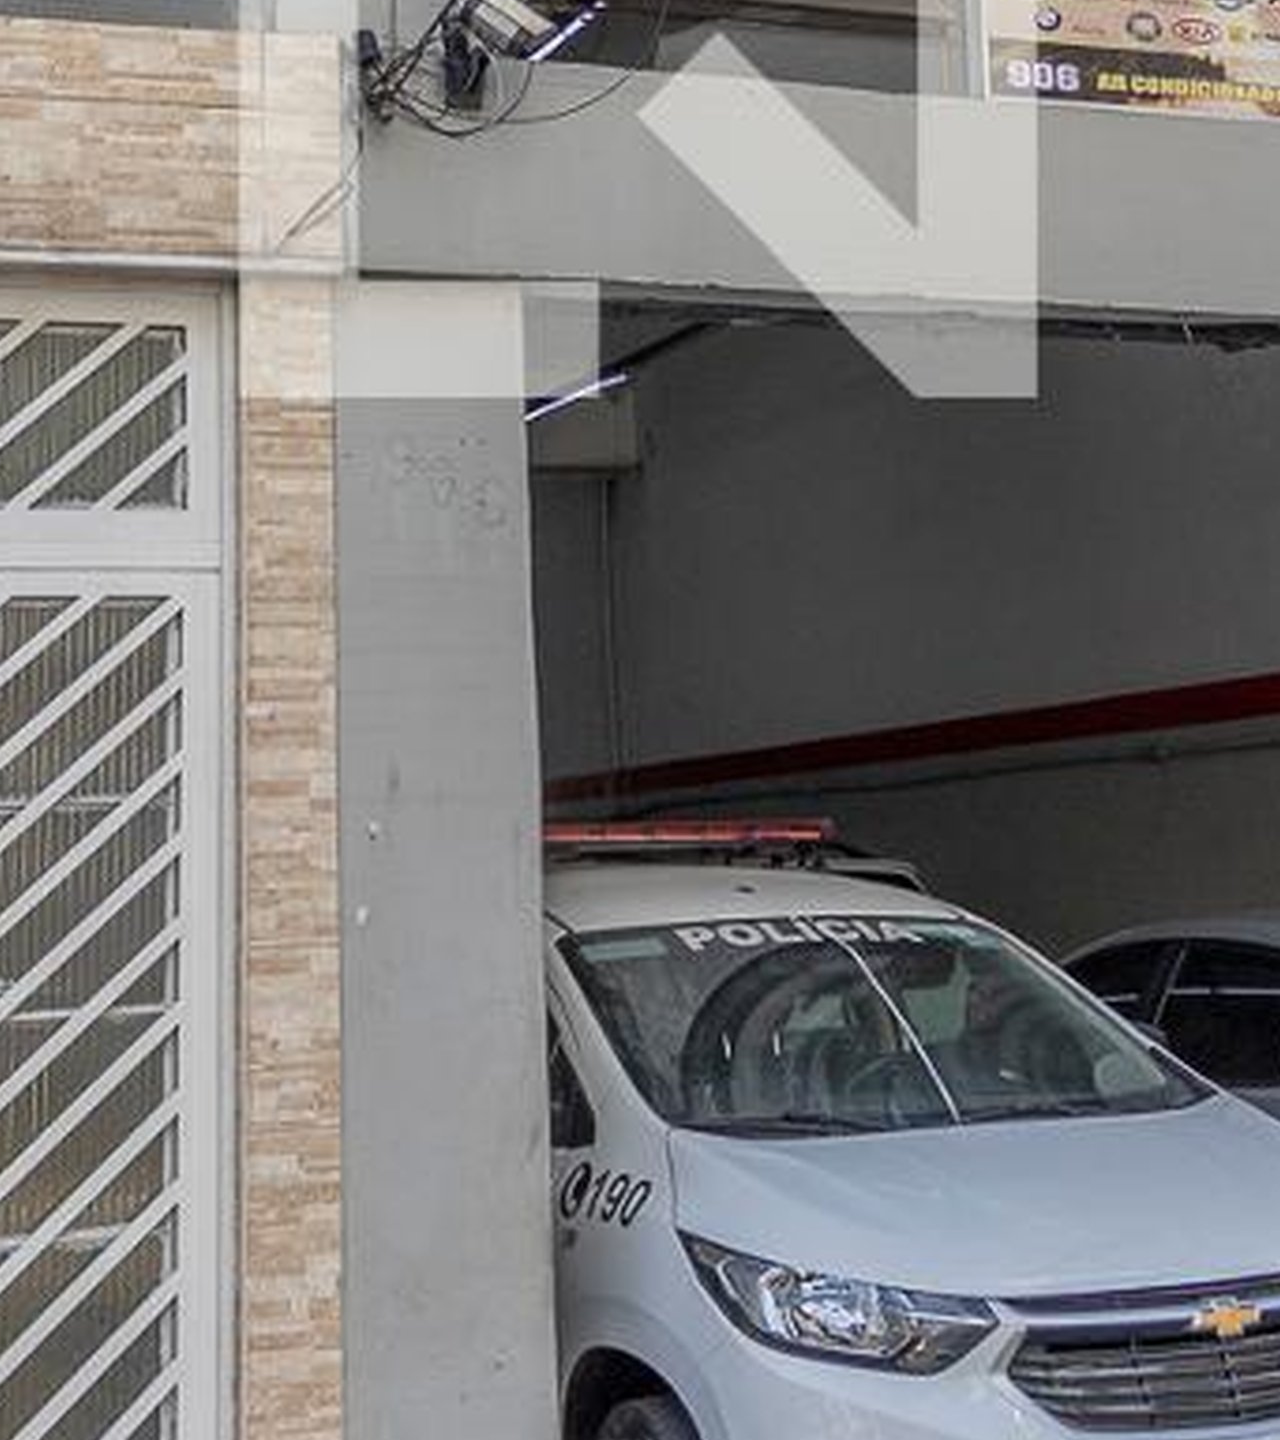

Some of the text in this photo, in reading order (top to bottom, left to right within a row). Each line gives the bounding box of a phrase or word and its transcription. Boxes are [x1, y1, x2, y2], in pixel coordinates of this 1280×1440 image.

[1006, 59, 1080, 92] 906
[673, 917, 925, 952] POLÍCIA
[586, 1168, 653, 1228] 190
